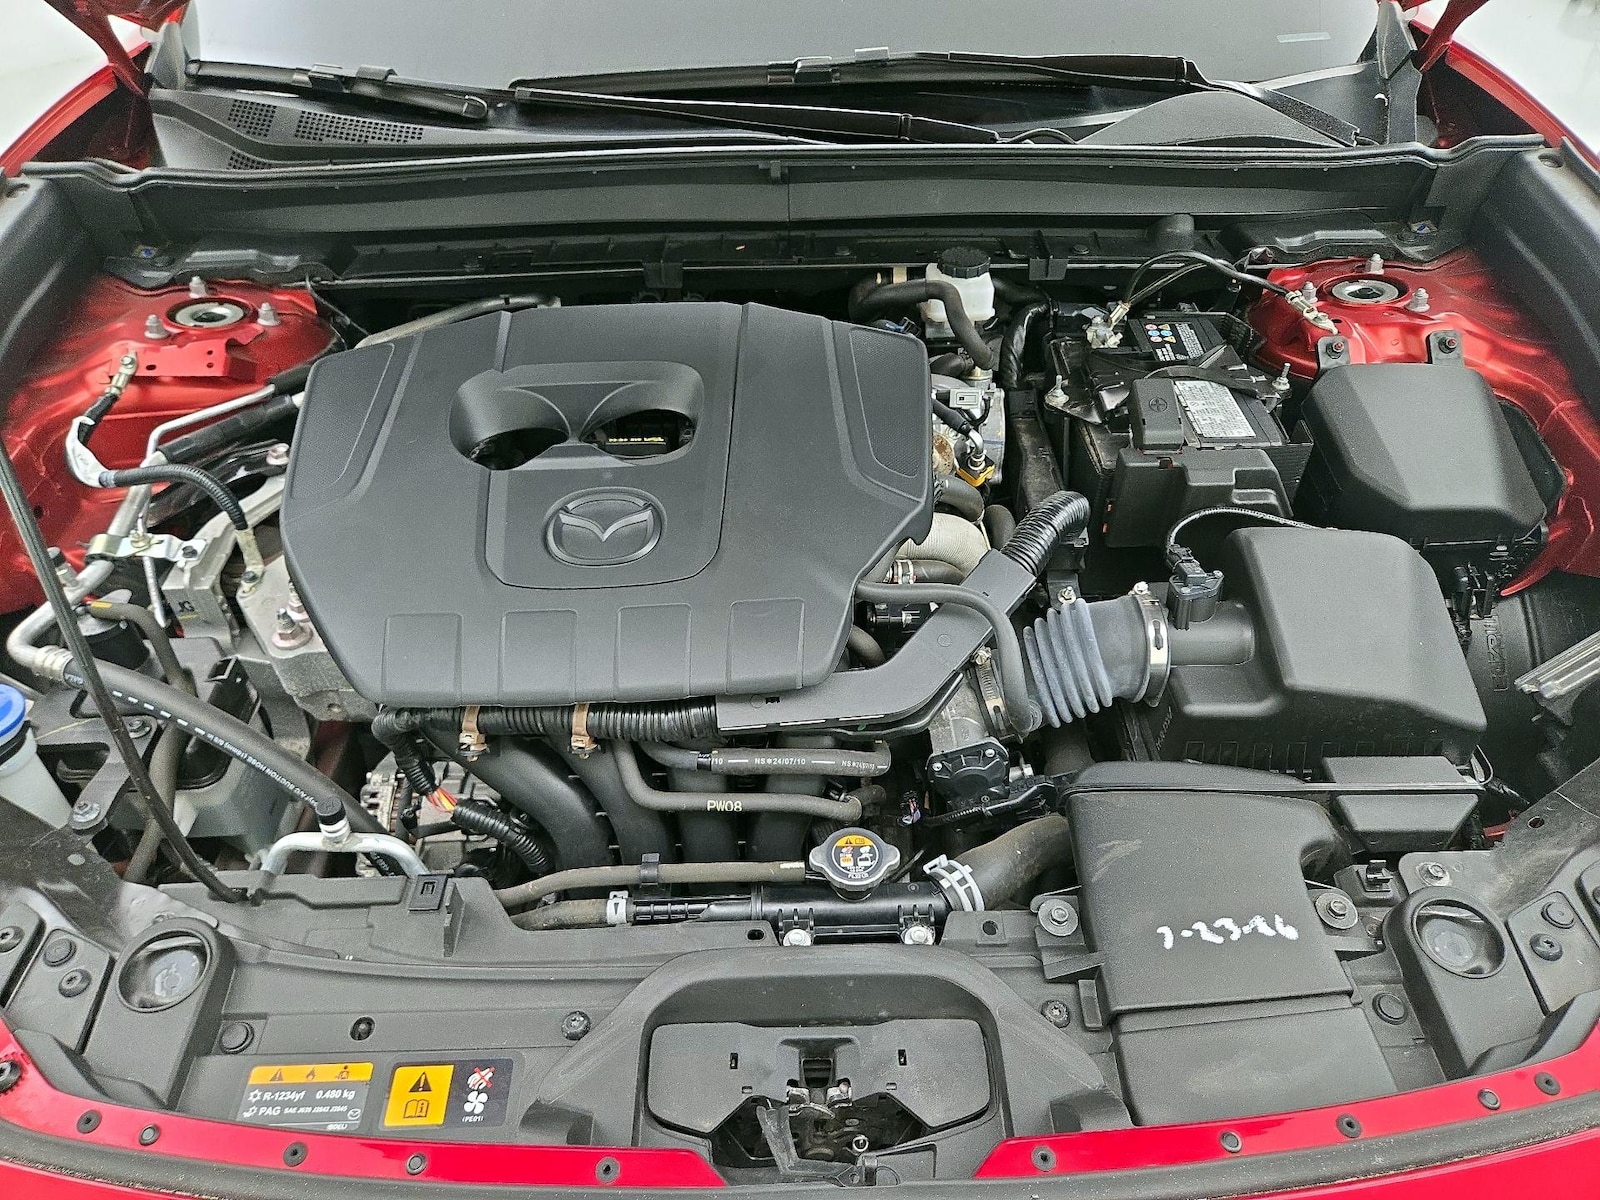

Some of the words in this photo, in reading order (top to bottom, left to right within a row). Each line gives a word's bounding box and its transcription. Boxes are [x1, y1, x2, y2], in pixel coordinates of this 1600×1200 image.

[707, 800, 743, 812] PW08
[262, 1090, 306, 1102] R-1234yf
[315, 1089, 341, 1100] 0.480
[342, 1089, 355, 1100] kg
[258, 1106, 281, 1116] PAG
